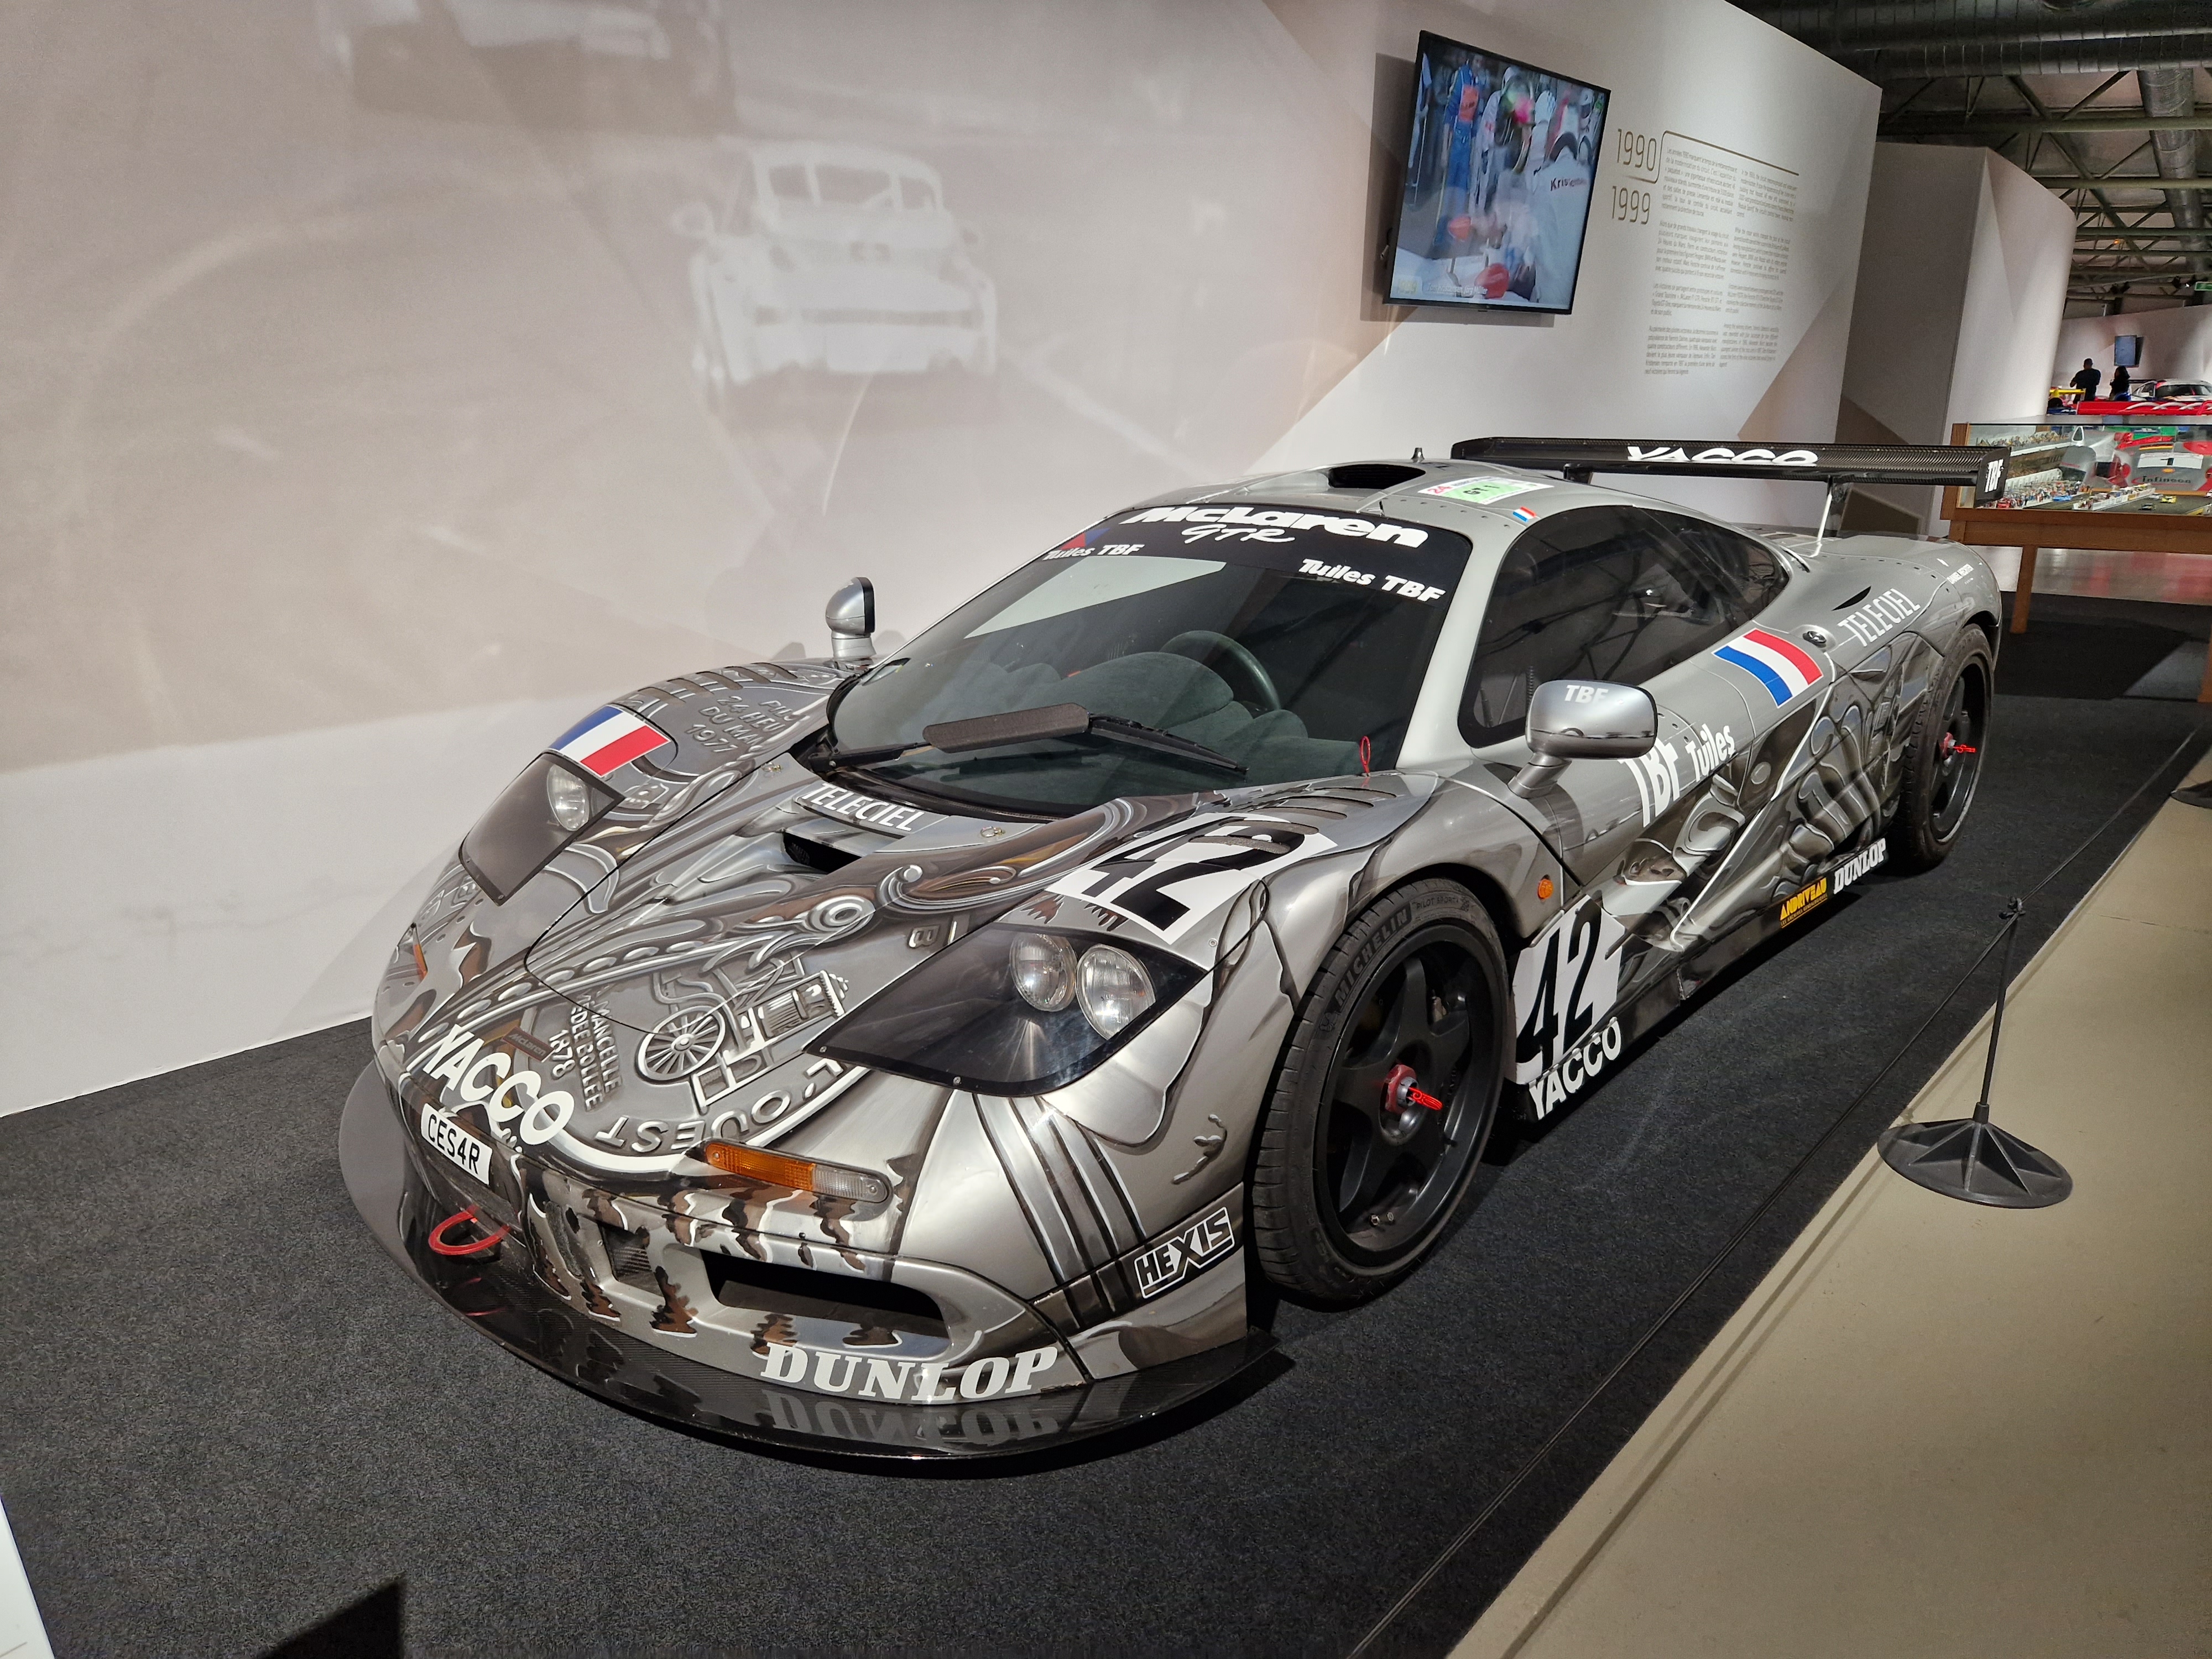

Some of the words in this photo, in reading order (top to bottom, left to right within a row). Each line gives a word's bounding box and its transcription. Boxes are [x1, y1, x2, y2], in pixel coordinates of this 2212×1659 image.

[1617, 128, 1657, 171] 1990
[1611, 185, 1651, 225] 1999
[1627, 446, 1818, 467] YACCO
[1984, 458, 2004, 493] TBF
[2142, 476, 2191, 484] Infineon
[1042, 547, 1095, 561] Tuiles
[1097, 544, 1145, 556] TBF
[1181, 524, 1295, 544] GTR
[1298, 558, 1375, 586] Tuiles
[1381, 575, 1446, 603] TBF
[1837, 588, 1921, 648] TELECIEL
[698, 706, 735, 725] DU
[717, 695, 750, 713] 24
[1564, 685, 1609, 704] TBF
[684, 723, 739, 753] 1977
[1684, 723, 1735, 783] Tuiles
[802, 782, 926, 833] TELECIEL
[1081, 816, 1306, 931] 42
[1833, 837, 1886, 895] DUNLOP
[1780, 877, 1827, 921] ANDRIVEAU
[1334, 907, 1408, 1007] MICHELIN
[1516, 897, 1602, 1074] 42
[549, 1029, 576, 1077] 1878
[1528, 1016, 1621, 1120] YACCO
[422, 1024, 575, 1145] YACCO
[428, 1114, 481, 1175] CES4R
[1135, 1208, 1234, 1292] HEXIS
[761, 1342, 1058, 1401] DUNLOP
